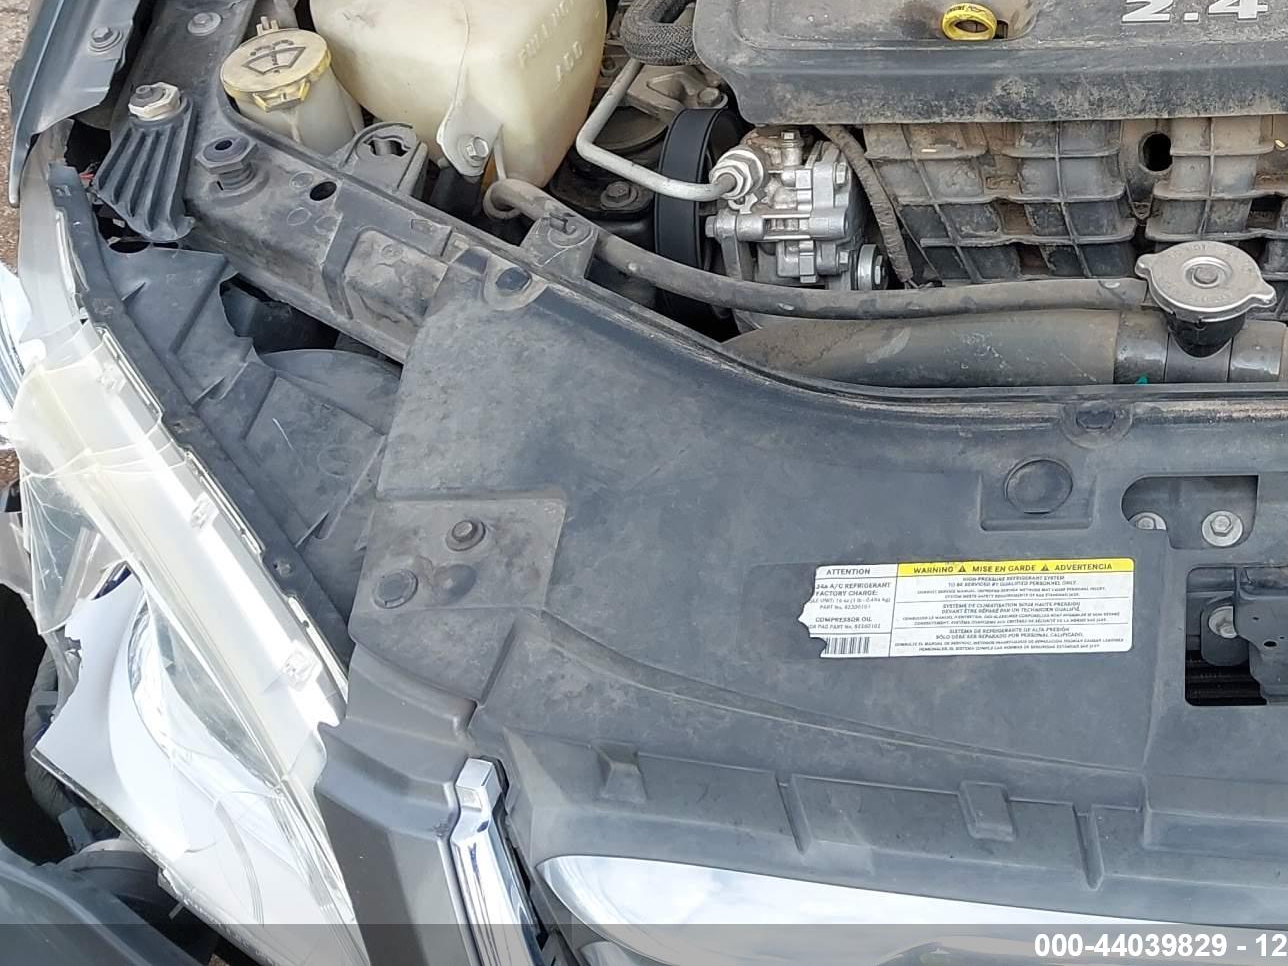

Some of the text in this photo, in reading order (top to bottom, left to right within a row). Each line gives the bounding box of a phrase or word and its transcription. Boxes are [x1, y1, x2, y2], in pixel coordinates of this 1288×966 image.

[972, 565, 994, 573] MISE
[1008, 564, 1038, 572] GARDE
[1054, 563, 1113, 571] ADVERTENCIA
